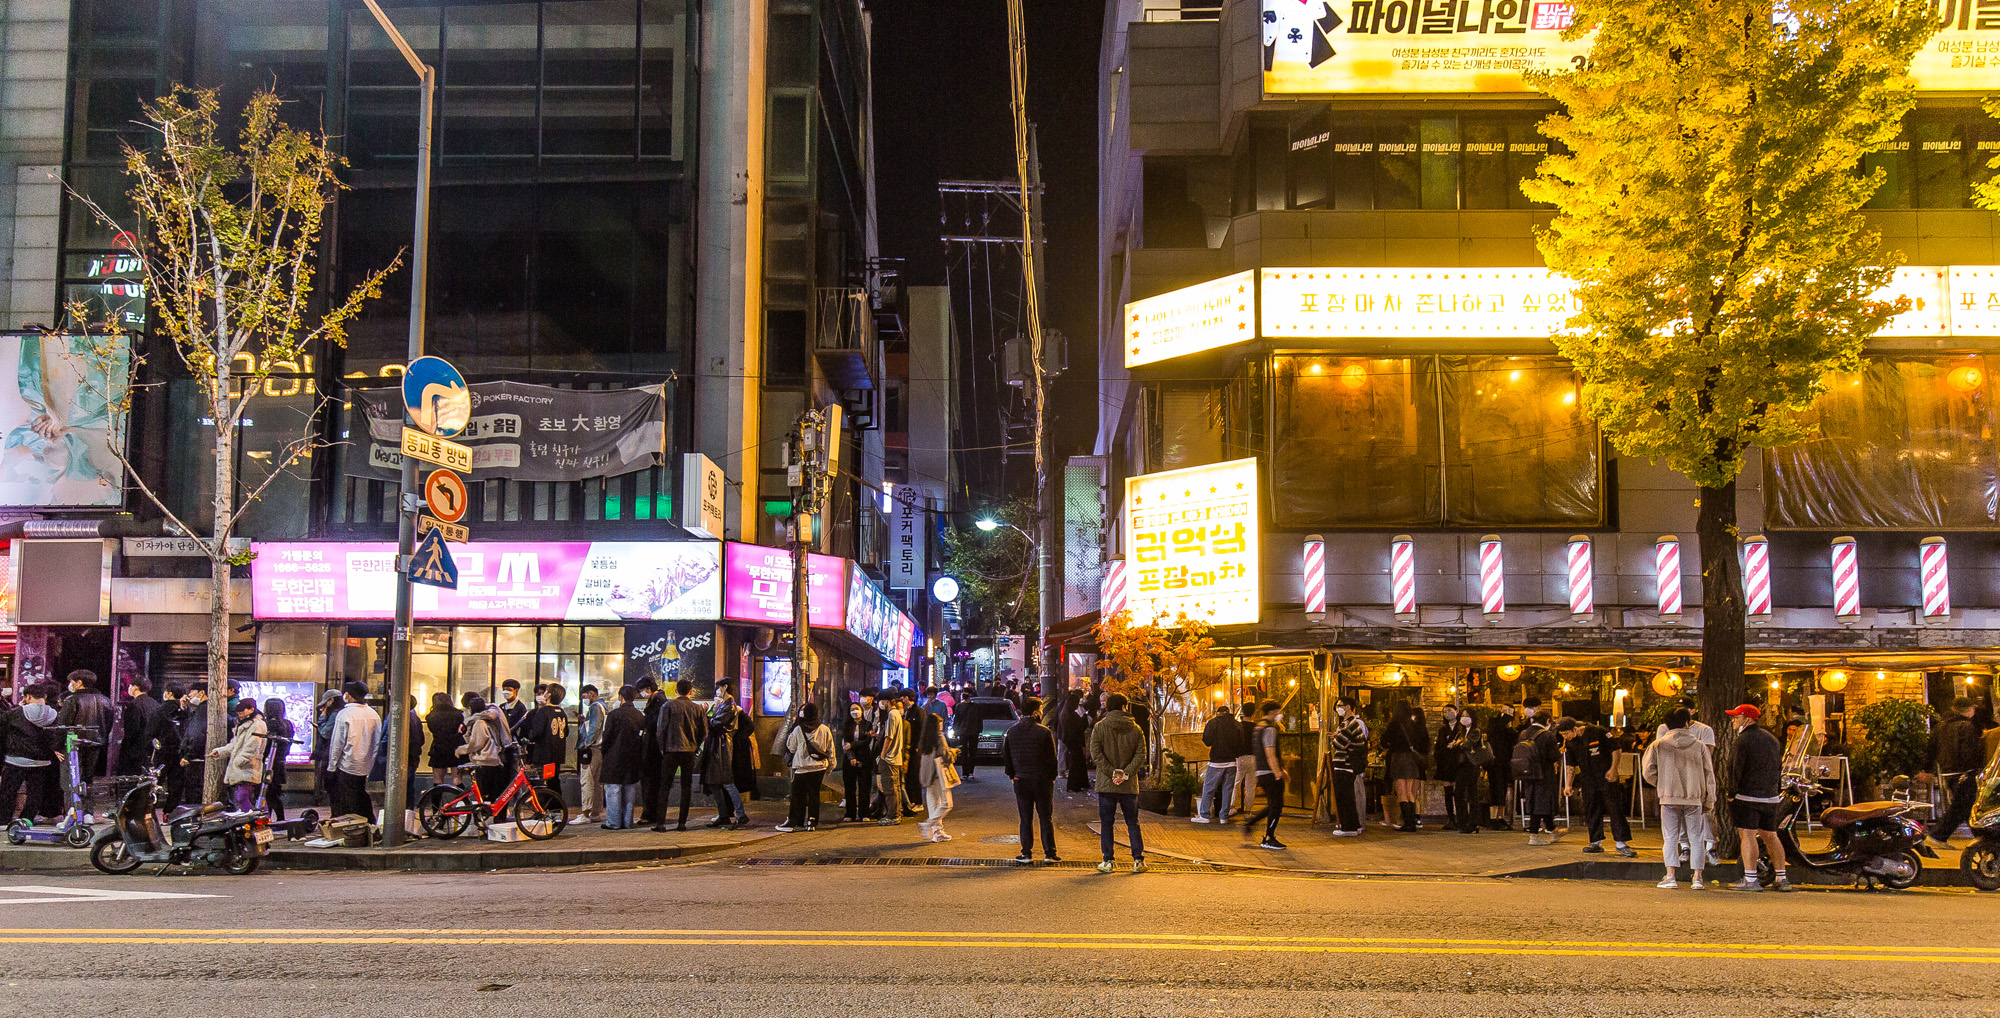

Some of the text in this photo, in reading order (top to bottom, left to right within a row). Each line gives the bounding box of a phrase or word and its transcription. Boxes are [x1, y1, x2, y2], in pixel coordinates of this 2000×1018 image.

[1346, 0, 1531, 35] 파이널나인
[1535, 15, 1560, 29] 포커
[1938, 40, 1973, 53] 여성분
[1391, 48, 1546, 58] 여성분 남성분 친구끼리도 혼자오셔도
[1401, 60, 1429, 70] 즐기실
[1431, 60, 1438, 70] 수
[1442, 60, 1461, 70] 있는
[1463, 60, 1491, 70] 신개념
[1951, 55, 1986, 68] 즐기실
[1291, 131, 1330, 151] 파이널나인
[1879, 141, 1910, 150] 이널나인
[1921, 141, 1961, 150] 파이널나인
[1334, 143, 1373, 152] 파이널나인
[1378, 143, 1417, 152] 파이널나인
[1422, 143, 1461, 152] 파이널나인
[1466, 143, 1505, 152] 파이널나인
[1509, 143, 1548, 152] 파이널나인
[1300, 293, 1402, 313] 포장마차
[1416, 293, 1505, 313] 존나하고
[483, 393, 554, 405] POKER FACTORY
[493, 418, 516, 434] 홀덤
[538, 414, 621, 432] 초보 大 환영
[406, 434, 468, 467] 동교동 방면
[136, 541, 174, 550] 이자카야
[177, 541, 195, 551] 단심
[900, 506, 914, 576] 포커팩토리
[591, 560, 618, 570] 꽃등심
[1138, 561, 1246, 592] 포장마차
[270, 578, 336, 595] 무한리필
[585, 579, 611, 589] 갈비살
[577, 597, 604, 608] 부채살
[674, 606, 713, 615] 336-3996
